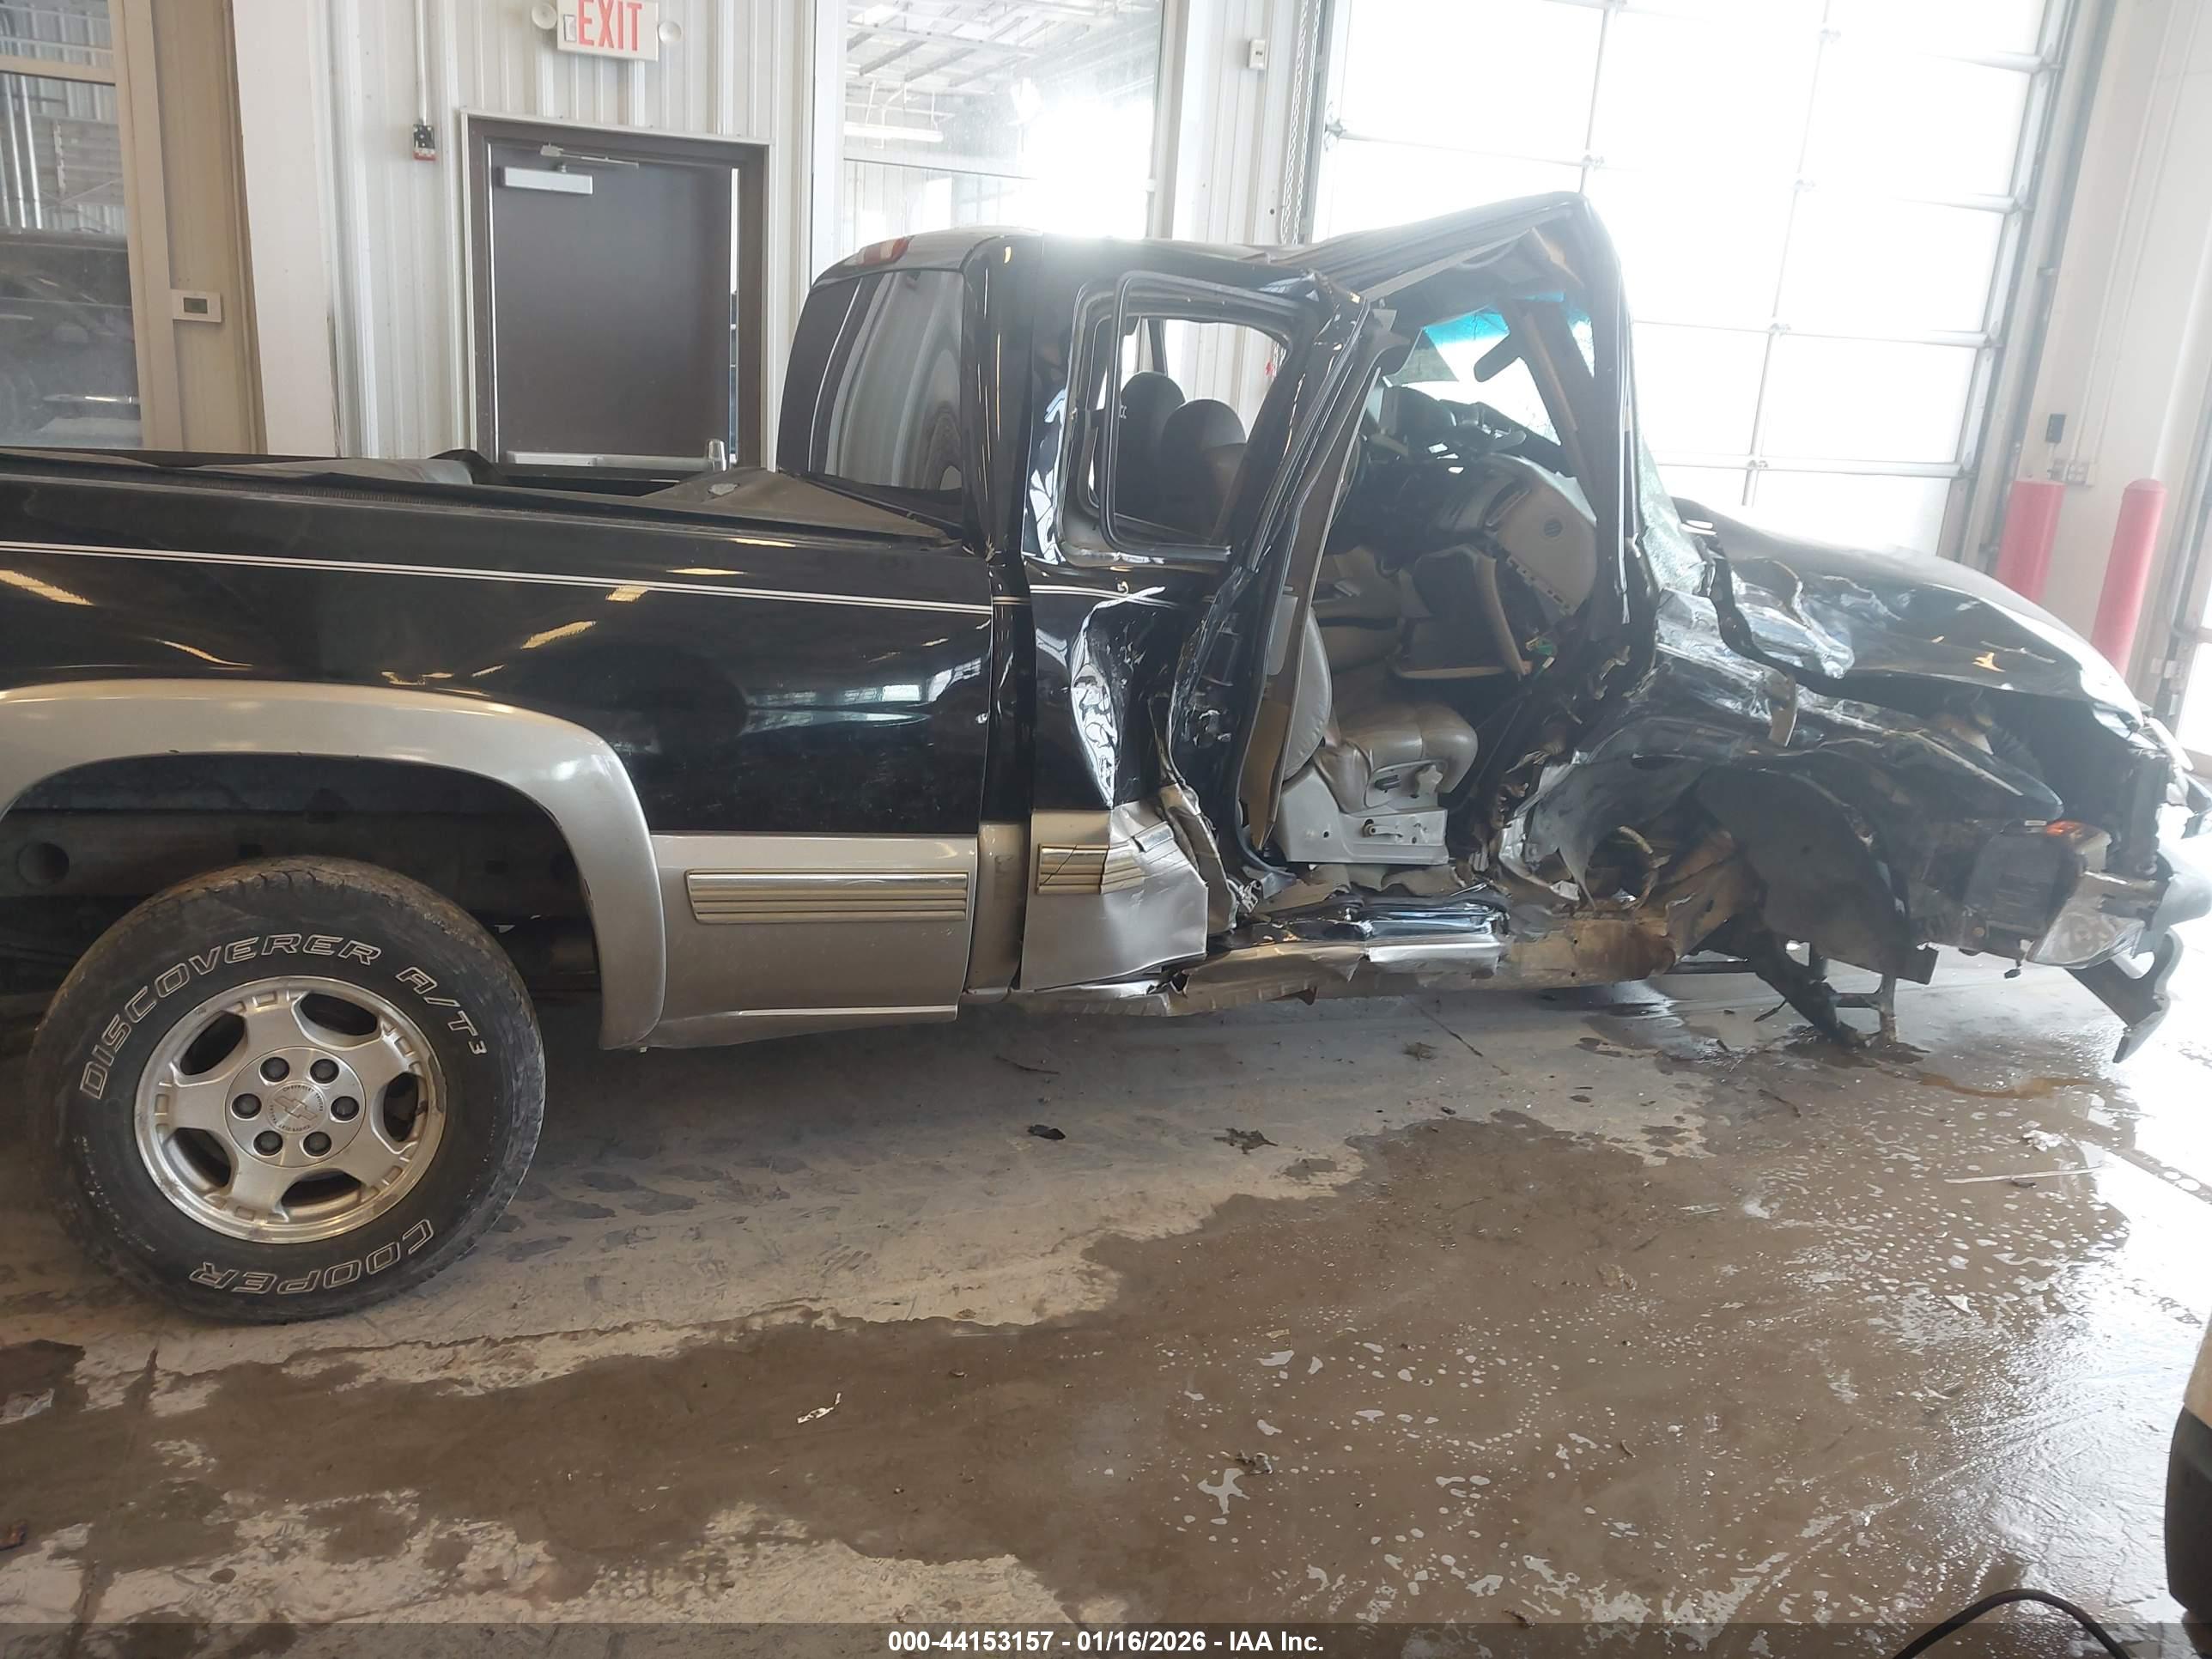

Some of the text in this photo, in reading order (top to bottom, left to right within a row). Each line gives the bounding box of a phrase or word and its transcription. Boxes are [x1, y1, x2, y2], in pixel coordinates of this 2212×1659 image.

[578, 0, 642, 52] EXIT
[79, 933, 382, 1100] DISCOVERER
[188, 1218, 434, 1295] COOPER
